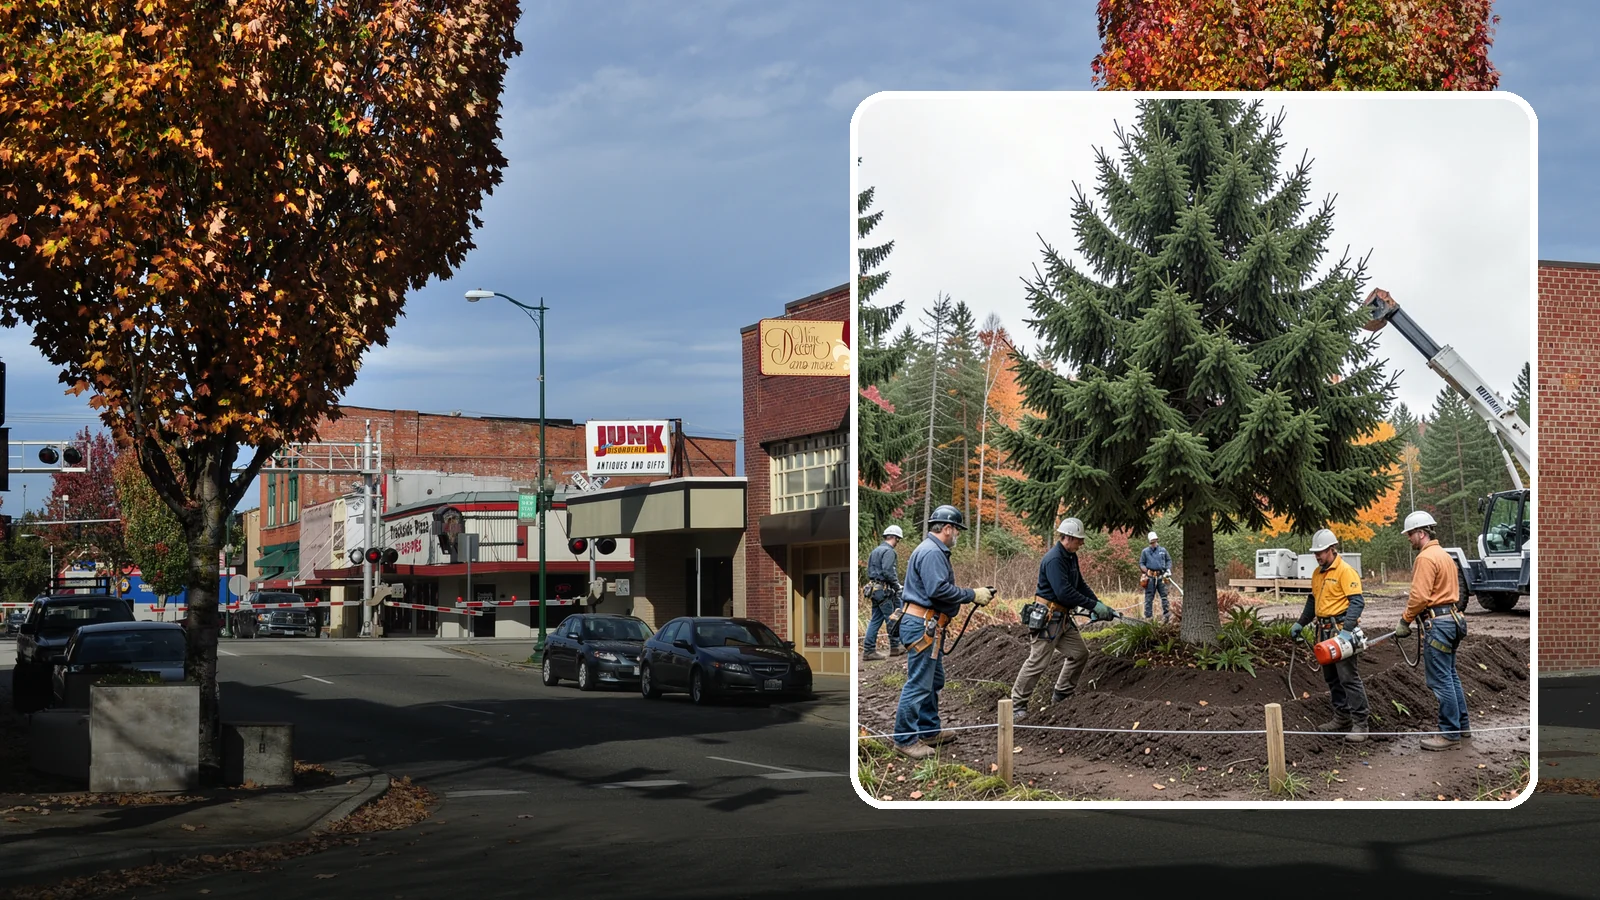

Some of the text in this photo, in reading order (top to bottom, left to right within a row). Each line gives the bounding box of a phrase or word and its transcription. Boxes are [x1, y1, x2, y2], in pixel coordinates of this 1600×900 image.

[765, 328, 830, 365] Decor
[595, 425, 665, 457] JUNK
[607, 446, 646, 454] DISORDERLY
[597, 460, 665, 470] ANTIQUES AND GIFTS
[414, 519, 429, 534] Pizza
